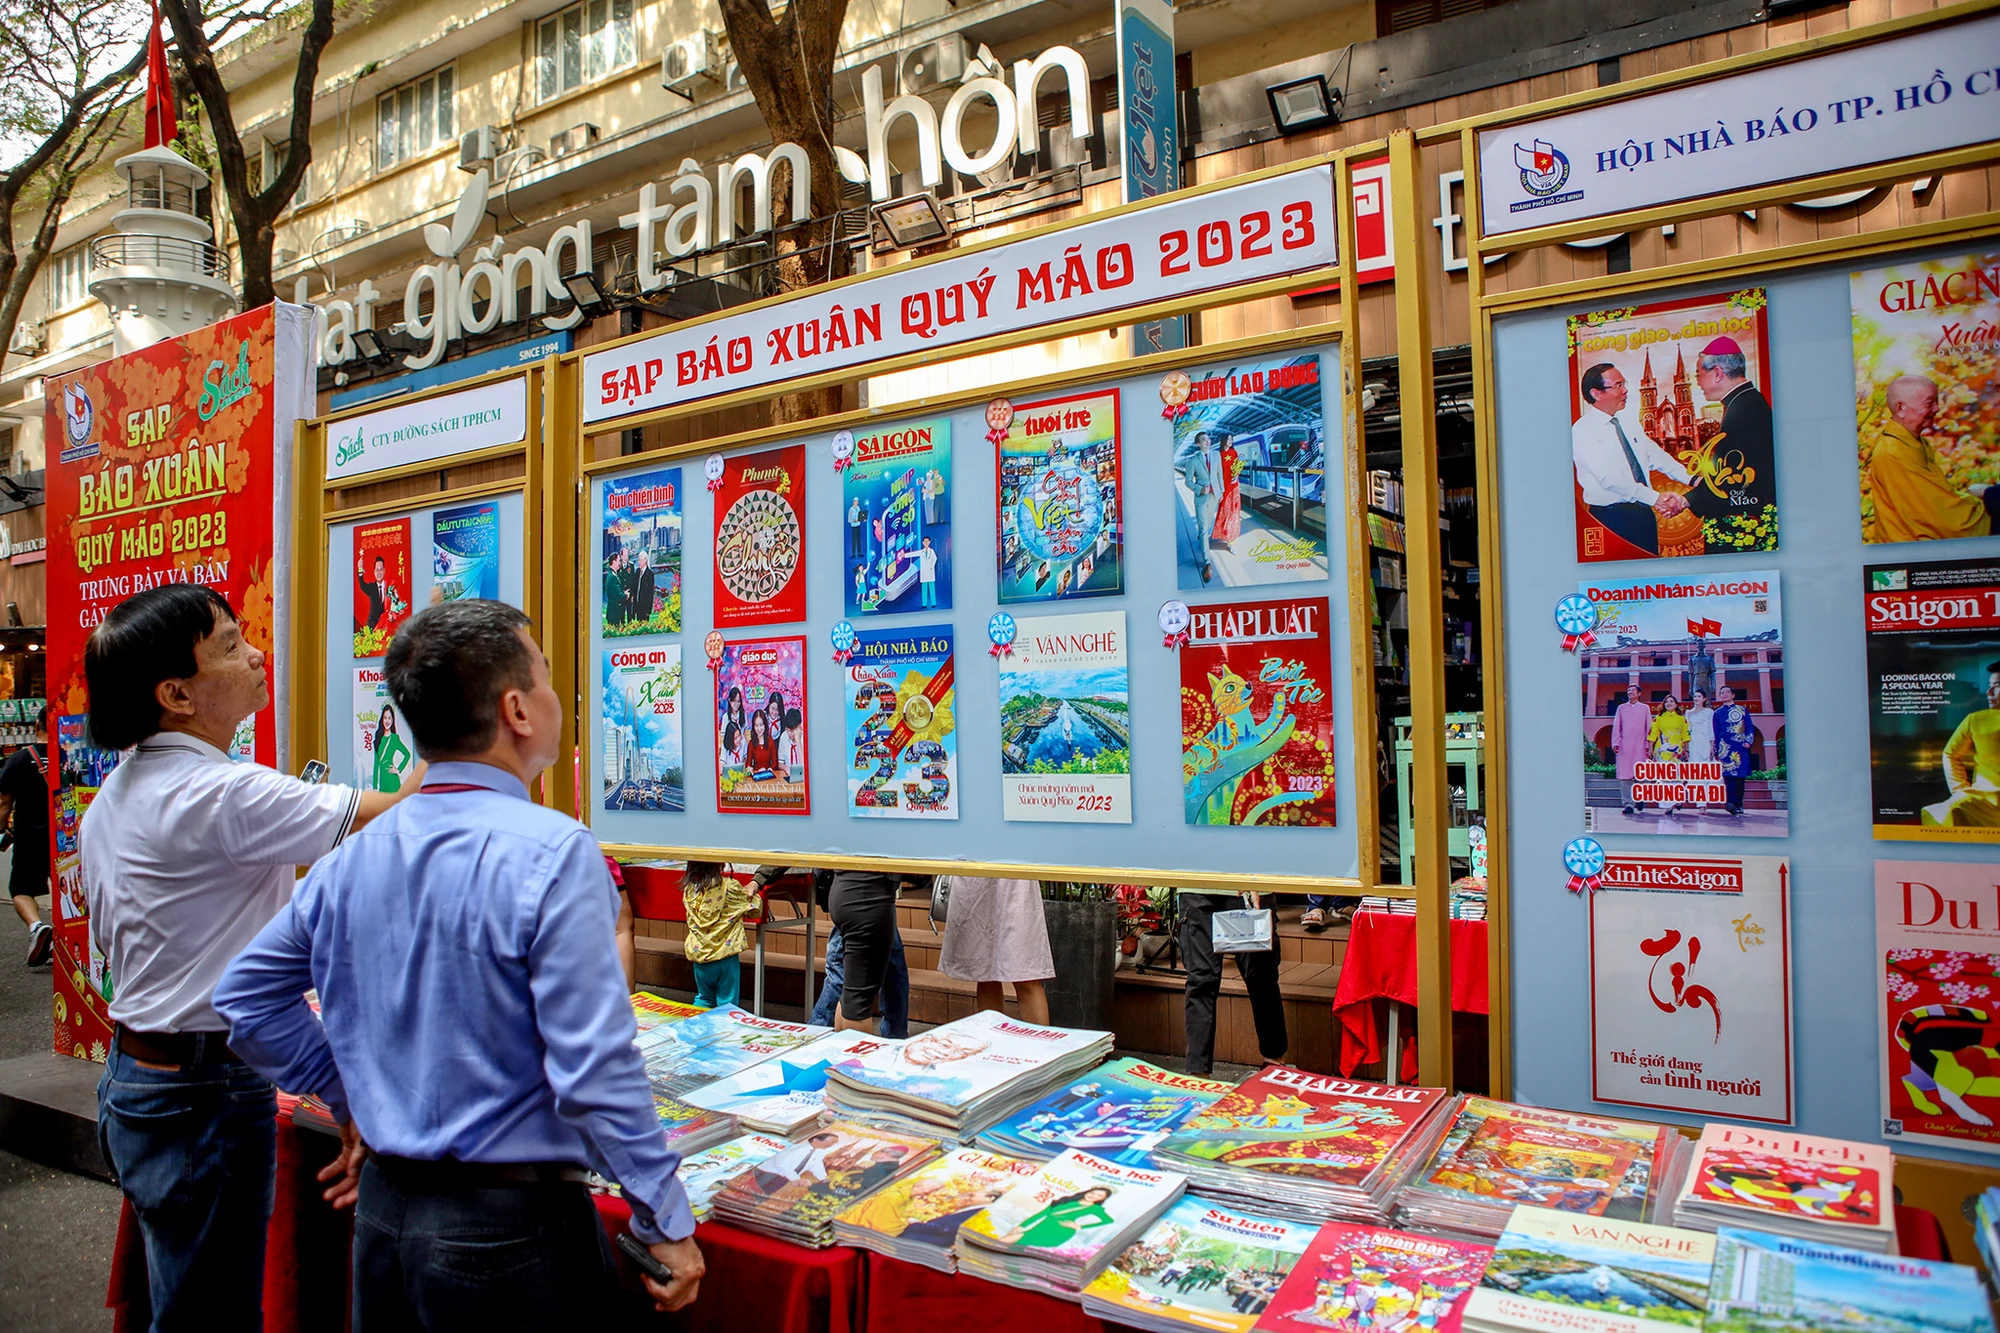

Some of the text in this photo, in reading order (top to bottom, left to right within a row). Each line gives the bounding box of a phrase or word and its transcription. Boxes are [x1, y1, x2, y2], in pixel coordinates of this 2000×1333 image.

[1596, 137, 1655, 173] HỘI
[1663, 120, 1735, 160] NHÀ
[1745, 105, 1818, 145] BÁO
[1827, 94, 1883, 126] TP.
[1893, 68, 1953, 113] HỒ
[403, 218, 594, 371] giống
[619, 142, 811, 292] tâm
[863, 42, 1093, 202] hồn
[599, 200, 1315, 407] SẠP BÁO XUÂN QUÝ MÃO 2023
[519, 341, 559, 362] SINCE 1994
[198, 340, 252, 422] Sách
[1187, 362, 1319, 402] GƯỜI LAO ĐỘNG
[127, 404, 172, 452] SẠP
[371, 408, 502, 449] CTY ĐƯỜNG SÁCH TPHCM
[1023, 406, 1092, 437] tuổi trẻ
[335, 426, 365, 467] Sách
[79, 439, 226, 517] BÁO XUÂN
[1023, 496, 1085, 531] Việt
[1729, 494, 1758, 508] Mão
[77, 511, 227, 574] QUÝ MÃO 2023
[80, 575, 131, 602] TRƯNG
[167, 561, 189, 585] VÀ
[194, 557, 229, 585] BÁN
[1871, 595, 1982, 627] Saigon
[1036, 630, 1118, 656] VĂN NGHỆ
[1618, 624, 1638, 635] 2023
[610, 651, 667, 668] Công an
[741, 649, 777, 666] giáo dục
[865, 638, 948, 660] HỘI NHÀ BÁO
[1881, 672, 1956, 682] LOOKING BACK ON
[1881, 681, 1944, 690] A SPECIAL YEAR
[653, 703, 675, 715] 2023
[1288, 776, 1323, 792] 2023
[1634, 761, 1722, 781] CÙNG NHAU
[1076, 795, 1113, 812] 2023
[1632, 782, 1726, 803] CHÚNG TA ĐI
[1896, 881, 1984, 931] Du
[1610, 1049, 1637, 1065] Thế
[1639, 1053, 1666, 1069] giới
[1640, 1070, 1762, 1098] cần tình người
[1316, 1151, 1366, 1165] 2023
[1723, 1130, 1867, 1162] Du lịch
[1071, 1153, 1123, 1175] Khoa
